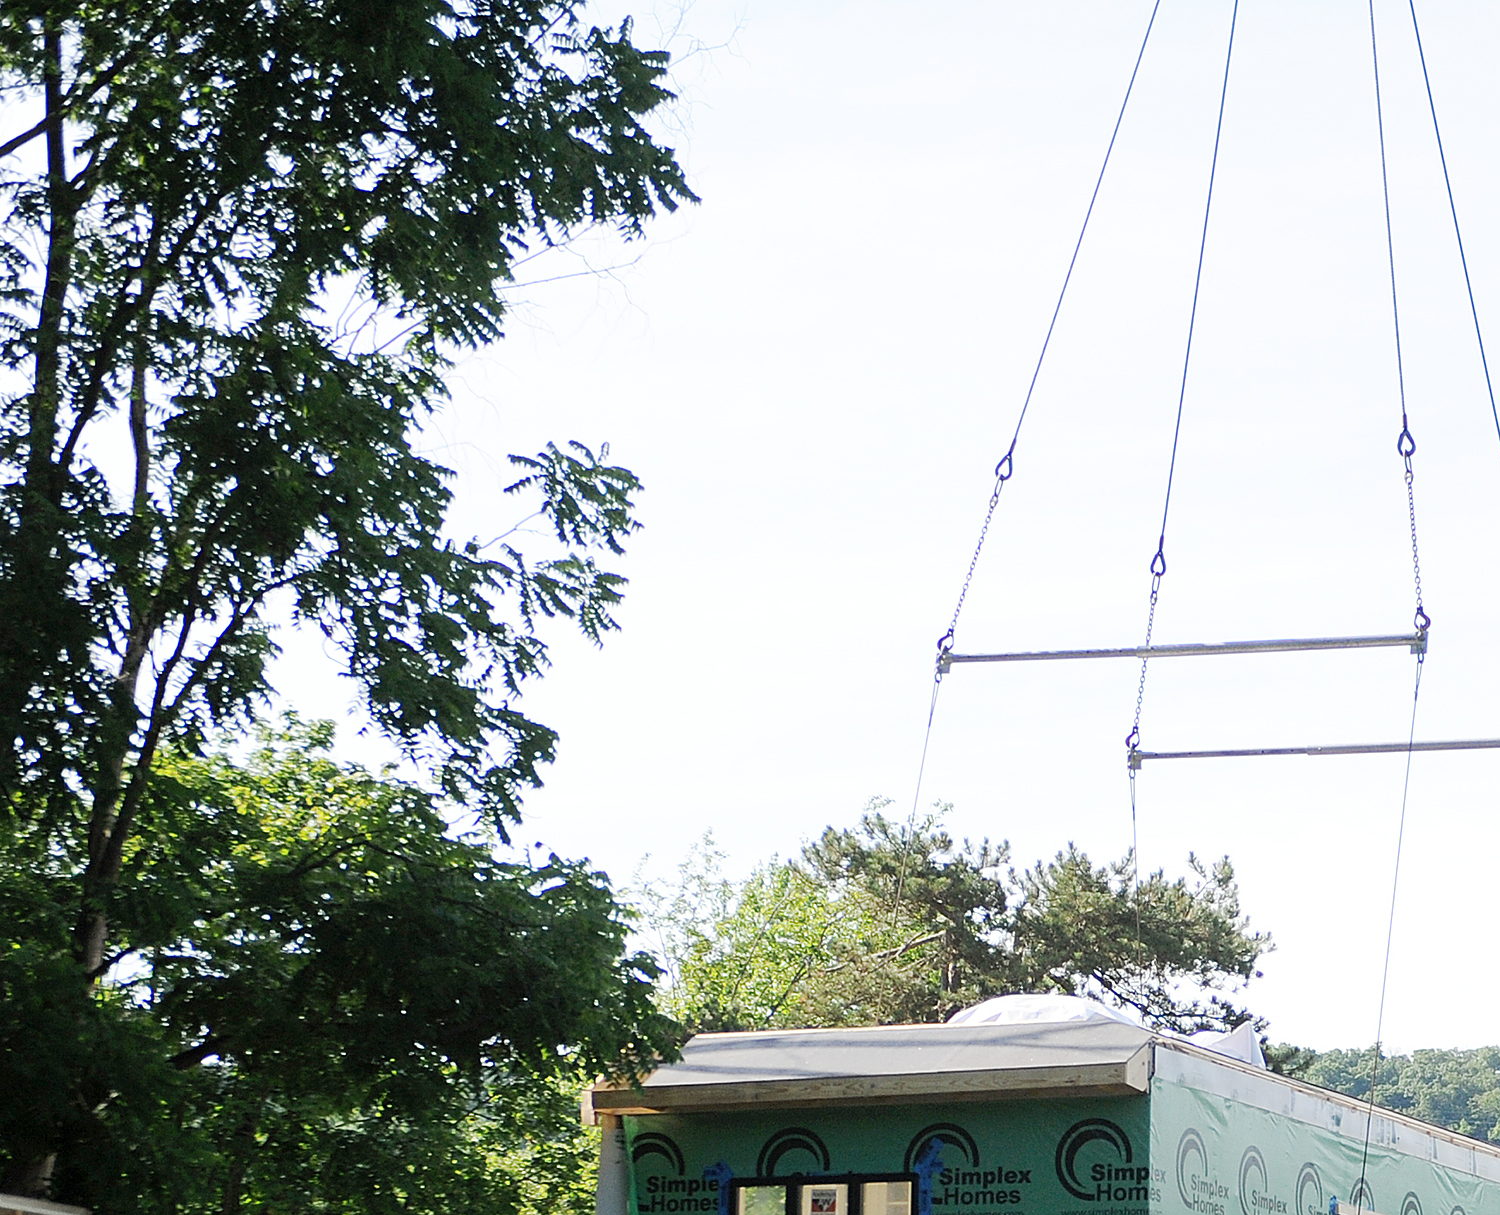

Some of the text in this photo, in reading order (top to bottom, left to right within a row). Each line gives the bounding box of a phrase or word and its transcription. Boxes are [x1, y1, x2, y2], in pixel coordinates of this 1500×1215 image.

[938, 1167, 1032, 1189] Simplex
[1090, 1162, 1167, 1185] Simplex
[647, 1175, 719, 1197] Simple
[943, 1188, 1022, 1206] Homes
[1096, 1183, 1162, 1203] Homes
[1190, 1174, 1230, 1200] Simplex
[650, 1194, 719, 1213] Homes
[1251, 1190, 1287, 1215] Simplex
